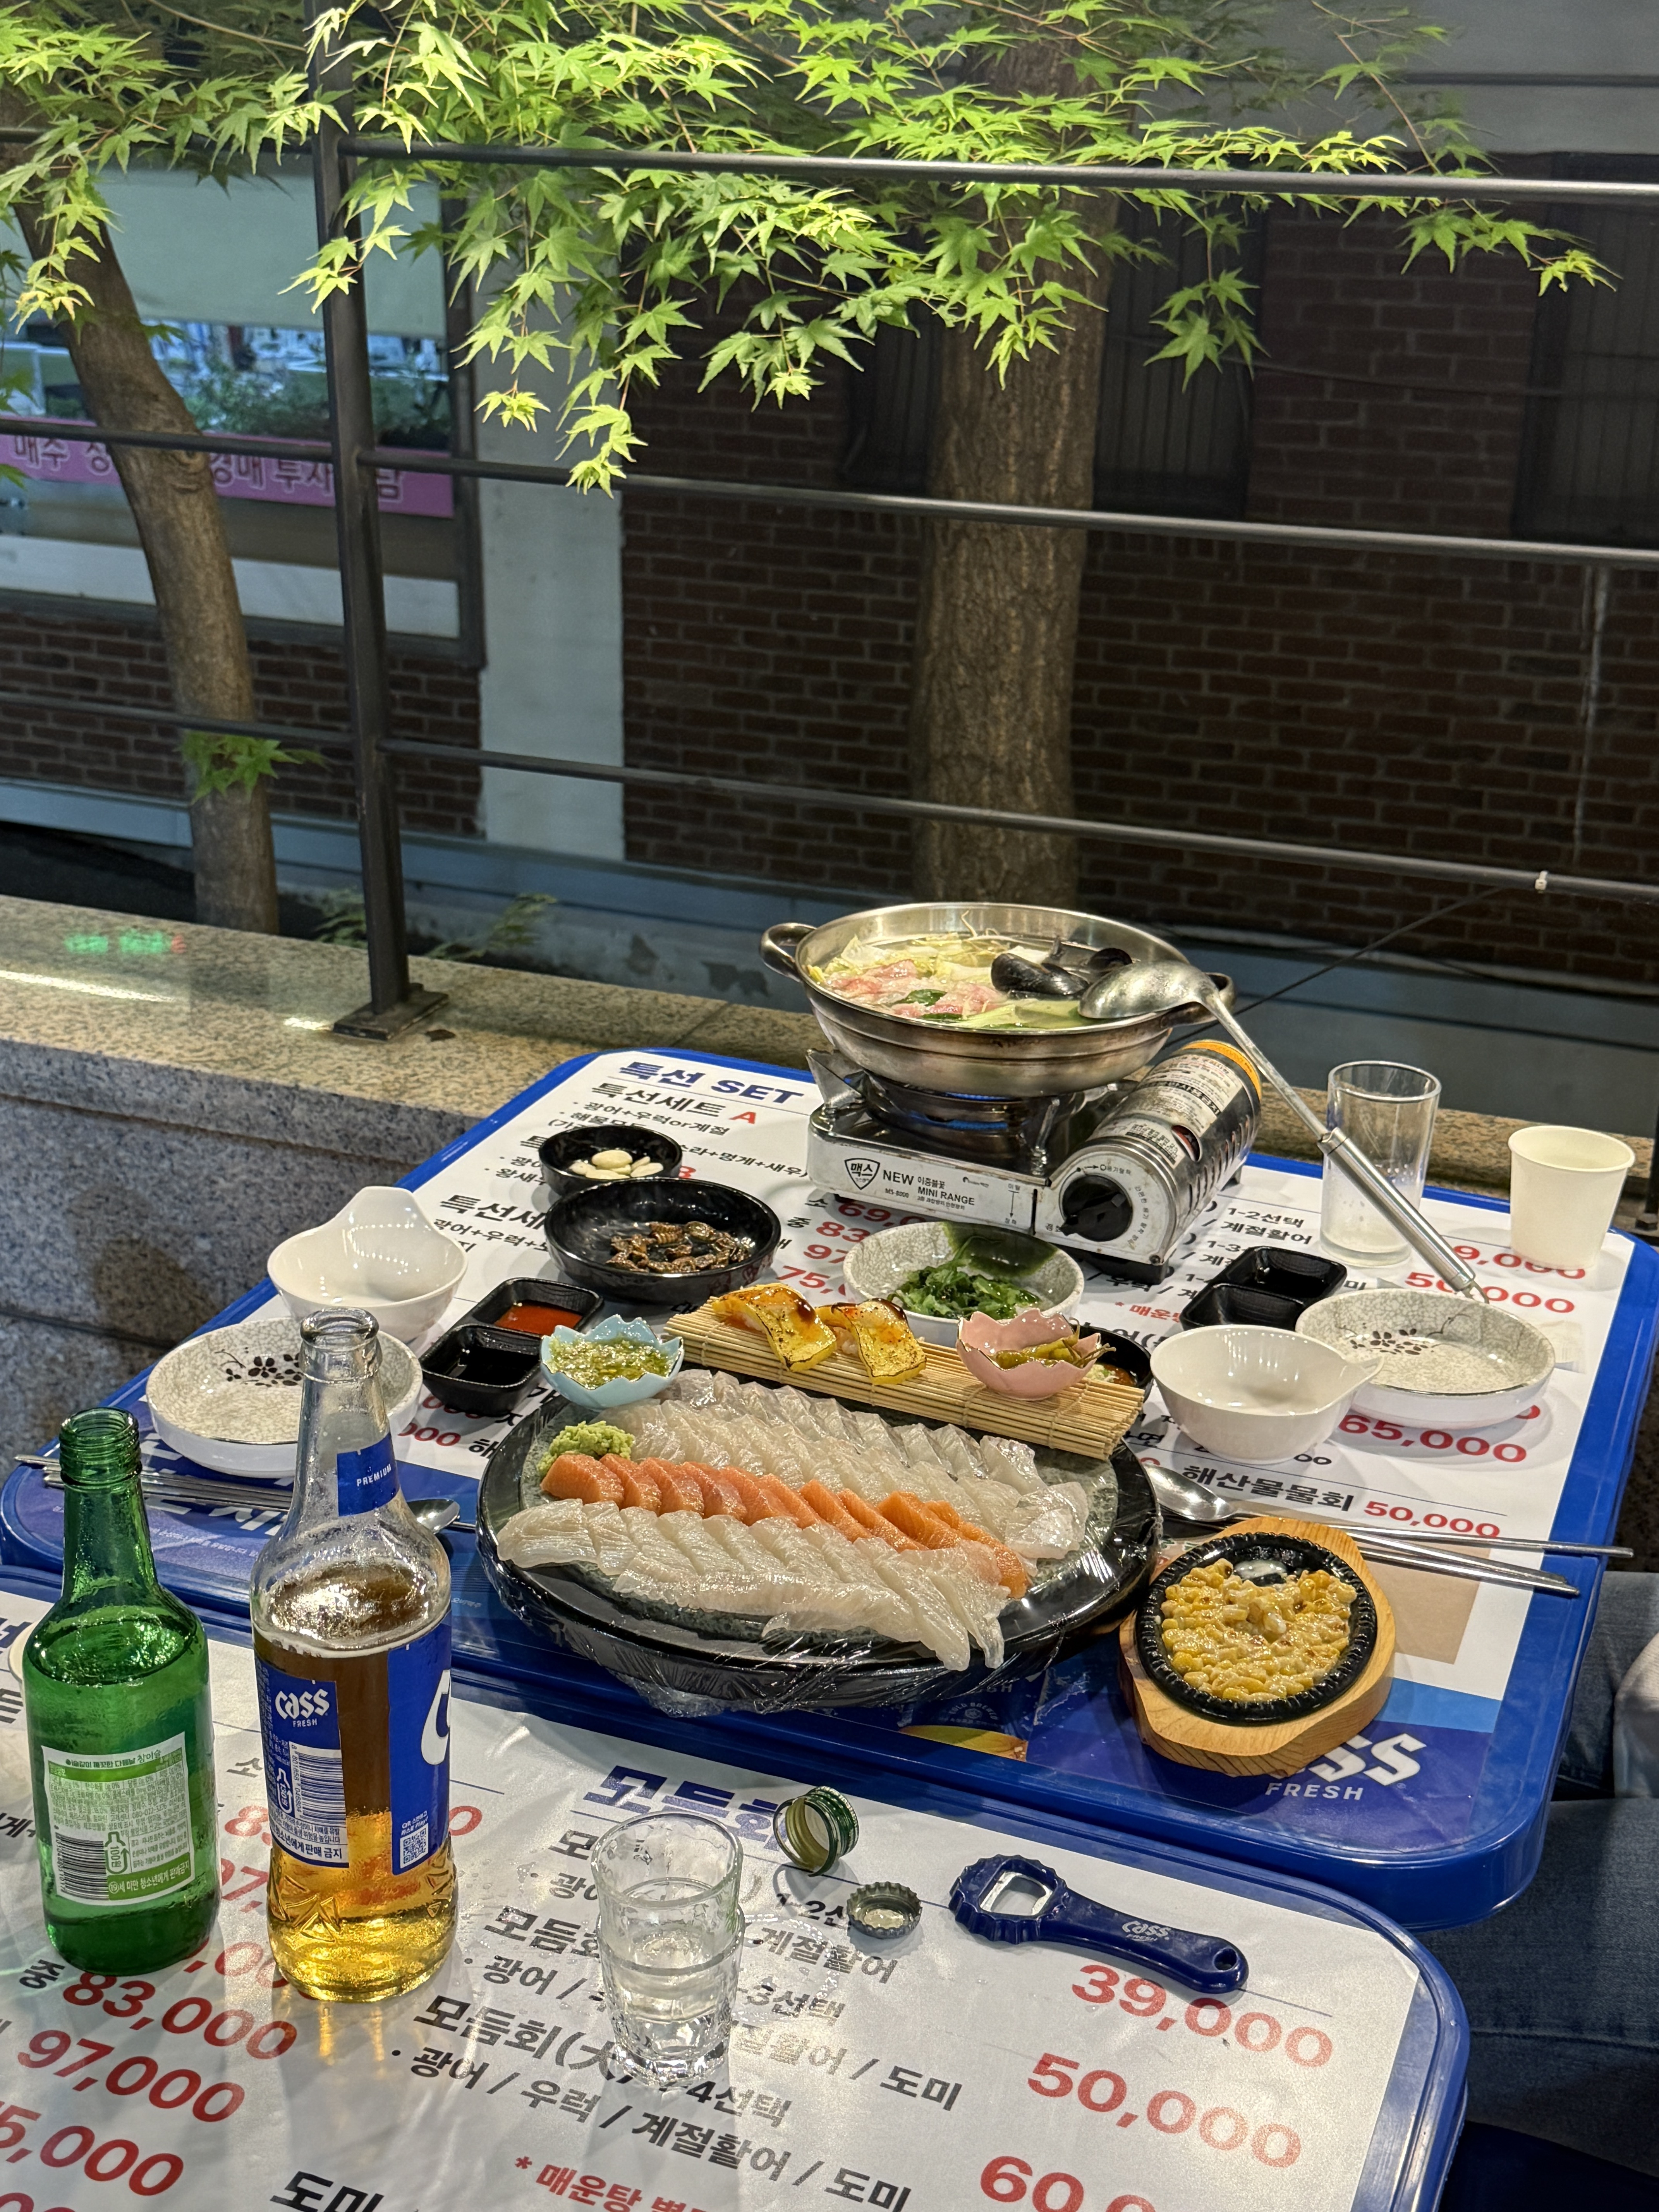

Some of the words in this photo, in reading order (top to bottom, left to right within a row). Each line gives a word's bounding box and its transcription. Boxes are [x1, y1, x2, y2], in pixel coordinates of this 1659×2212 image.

[619, 1061, 705, 1088] 특선
[711, 1079, 804, 1104] SET
[591, 1083, 726, 1117] 특선세트
[728, 1111, 757, 1124] A
[851, 1163, 873, 1177] 맥스
[883, 1170, 914, 1185] NEW
[440, 1195, 545, 1230] 특선세
[918, 1186, 938, 1197] MINI
[940, 1191, 975, 1206] RANGE
[1221, 1221, 1312, 1245] 계절활어
[1228, 1208, 1304, 1228] 1-2선택
[1338, 1414, 1527, 1463] 65,000
[356, 1463, 392, 1487] PREMIUM
[1182, 1465, 1354, 1512] 해산물물회
[1364, 1501, 1500, 1538] 50,000
[292, 1718, 318, 1728] FRESH
[226, 1757, 263, 1778] 소
[1264, 1782, 1364, 1801] FRESH
[402, 1820, 411, 1829] QR
[110, 1846, 122, 1868] 100원
[305, 1844, 322, 1857] 판매
[324, 1847, 342, 1859] 금지
[127, 1879, 139, 1891] 미만
[140, 1870, 169, 1889] 청소년에게
[19, 1959, 66, 1989] 중
[63, 1972, 297, 2060] 83,000
[1072, 1964, 1333, 2069] 39,000
[483, 1955, 558, 1995] 광어
[880, 2065, 963, 2112] 도미
[17, 2030, 245, 2123] 97,000
[1027, 2052, 1302, 2167] 50,000
[411, 2047, 489, 2089] 광어
[521, 2080, 601, 2123] 우럭
[632, 2111, 792, 2182] 계절활어
[824, 2167, 912, 2212] 도미
[0, 2100, 184, 2197] 5,000
[270, 2171, 385, 2212] 도미
[536, 2164, 642, 2212] 매운탕
